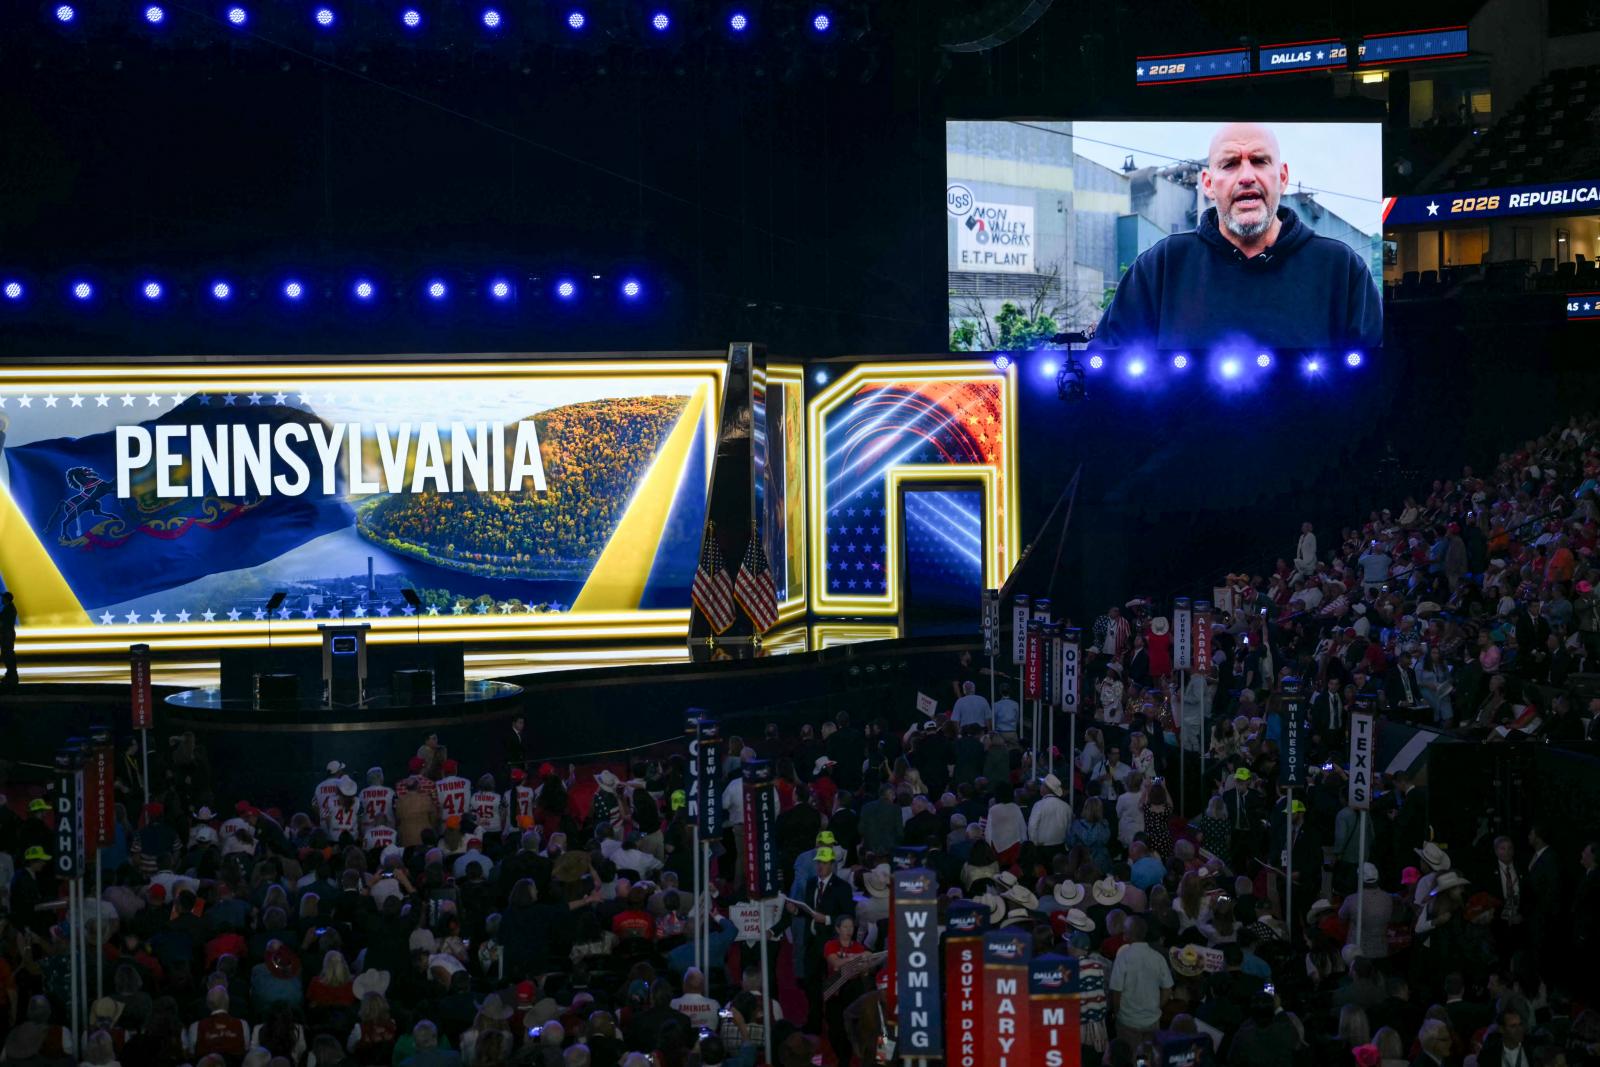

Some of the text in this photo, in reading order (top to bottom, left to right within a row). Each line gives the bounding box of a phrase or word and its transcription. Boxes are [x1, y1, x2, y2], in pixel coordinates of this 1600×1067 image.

[1149, 64, 1186, 75] 2026
[1271, 51, 1312, 64] DALLAS
[948, 193, 969, 208] USS
[973, 207, 1007, 220] MON
[1451, 187, 1600, 212] 2026 REPUBLICA
[989, 220, 1026, 233] VALLEY
[992, 233, 1031, 247] WORKS
[115, 420, 548, 498] PENNSYLVANIA
[1018, 610, 1026, 661] DELAWARE
[1198, 617, 1206, 671] ALABAMA
[1065, 650, 1075, 705] OHIO
[1288, 703, 1298, 781] MINNESOTA
[706, 747, 716, 775] NEW
[1354, 720, 1367, 802] TEXAS
[363, 790, 388, 799] TRUMP
[440, 781, 465, 792] TRUMP
[366, 800, 386, 817] 47
[444, 793, 465, 815] 47
[707, 780, 716, 834] JERSEY
[58, 778, 73, 872] IDAHO
[761, 792, 772, 892] CALIFORNIA
[904, 911, 929, 1048] WYOMING
[1033, 971, 1063, 980] DALLAS
[961, 950, 974, 1067] SOUTH DAKO
[1042, 1007, 1065, 1067] MIS
